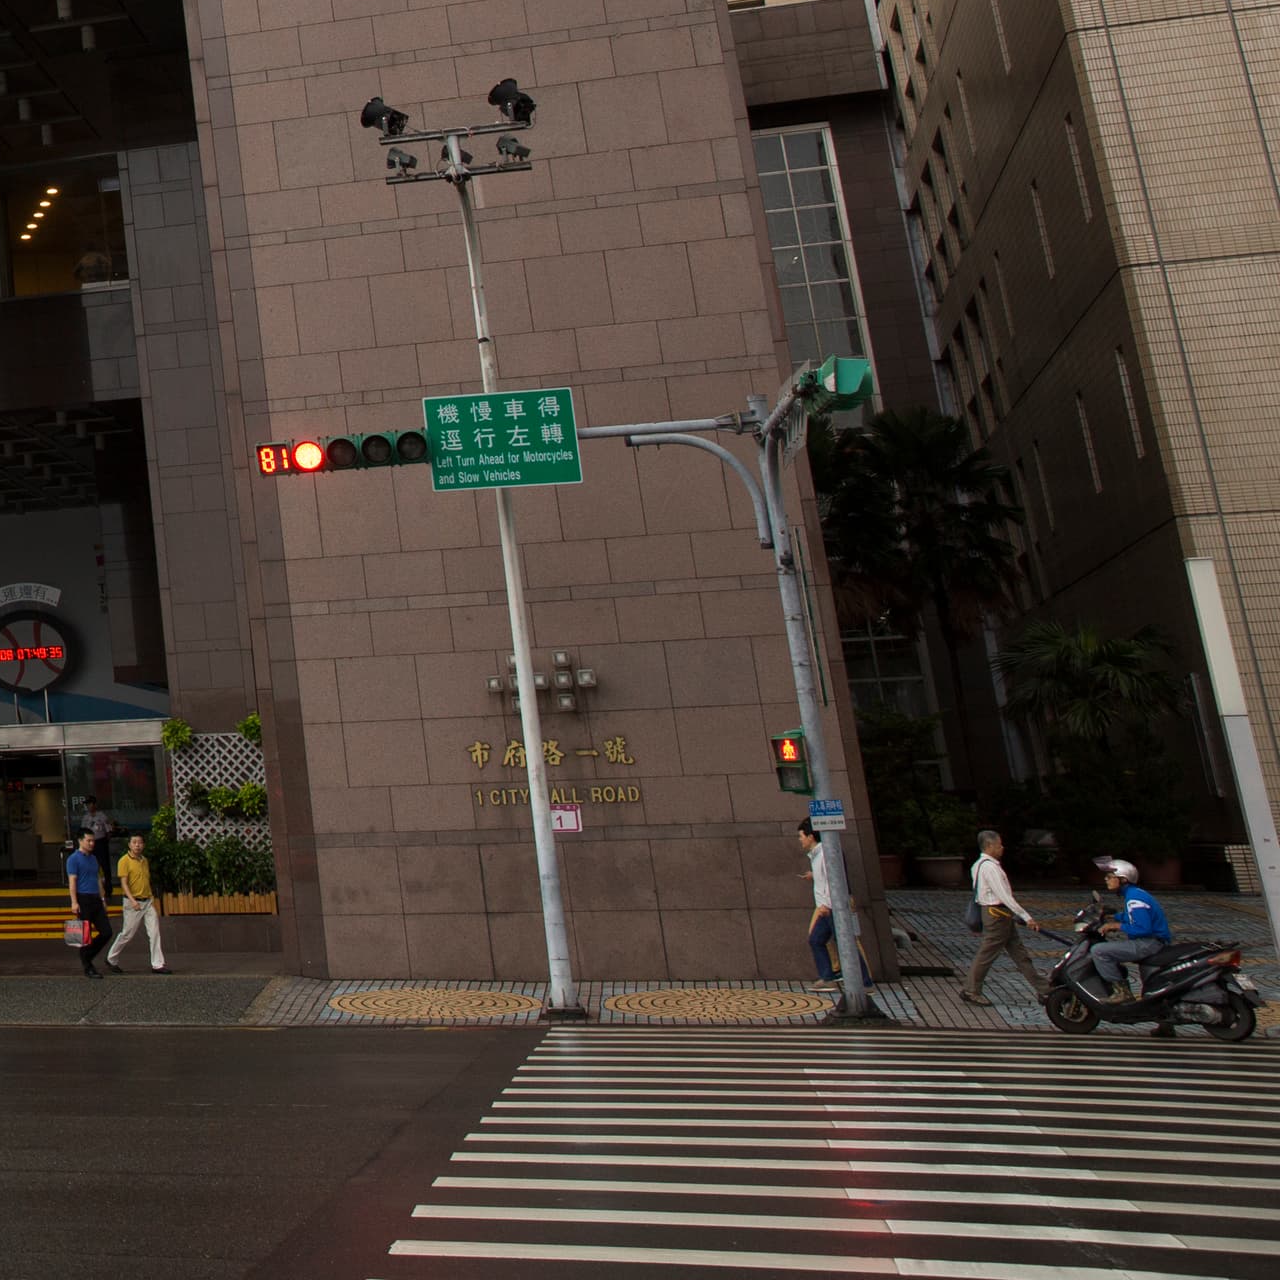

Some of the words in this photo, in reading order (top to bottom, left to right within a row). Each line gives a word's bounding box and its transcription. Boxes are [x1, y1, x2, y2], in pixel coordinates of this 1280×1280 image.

[436, 396, 561, 425] 機慢車得
[440, 422, 565, 451] 逕行左轉
[260, 447, 289, 474] 81
[436, 456, 453, 468] Left
[455, 455, 475, 467] Turn
[478, 453, 505, 466] Ahead
[507, 452, 520, 464] for
[523, 449, 574, 465] Motorcycles
[438, 473, 455, 485] and
[458, 471, 480, 483] Slow
[483, 470, 521, 482] Vehicles
[475, 791, 483, 806] 1
[490, 789, 530, 805] CITY
[591, 786, 641, 803] ROAD
[555, 815, 564, 829] 1
